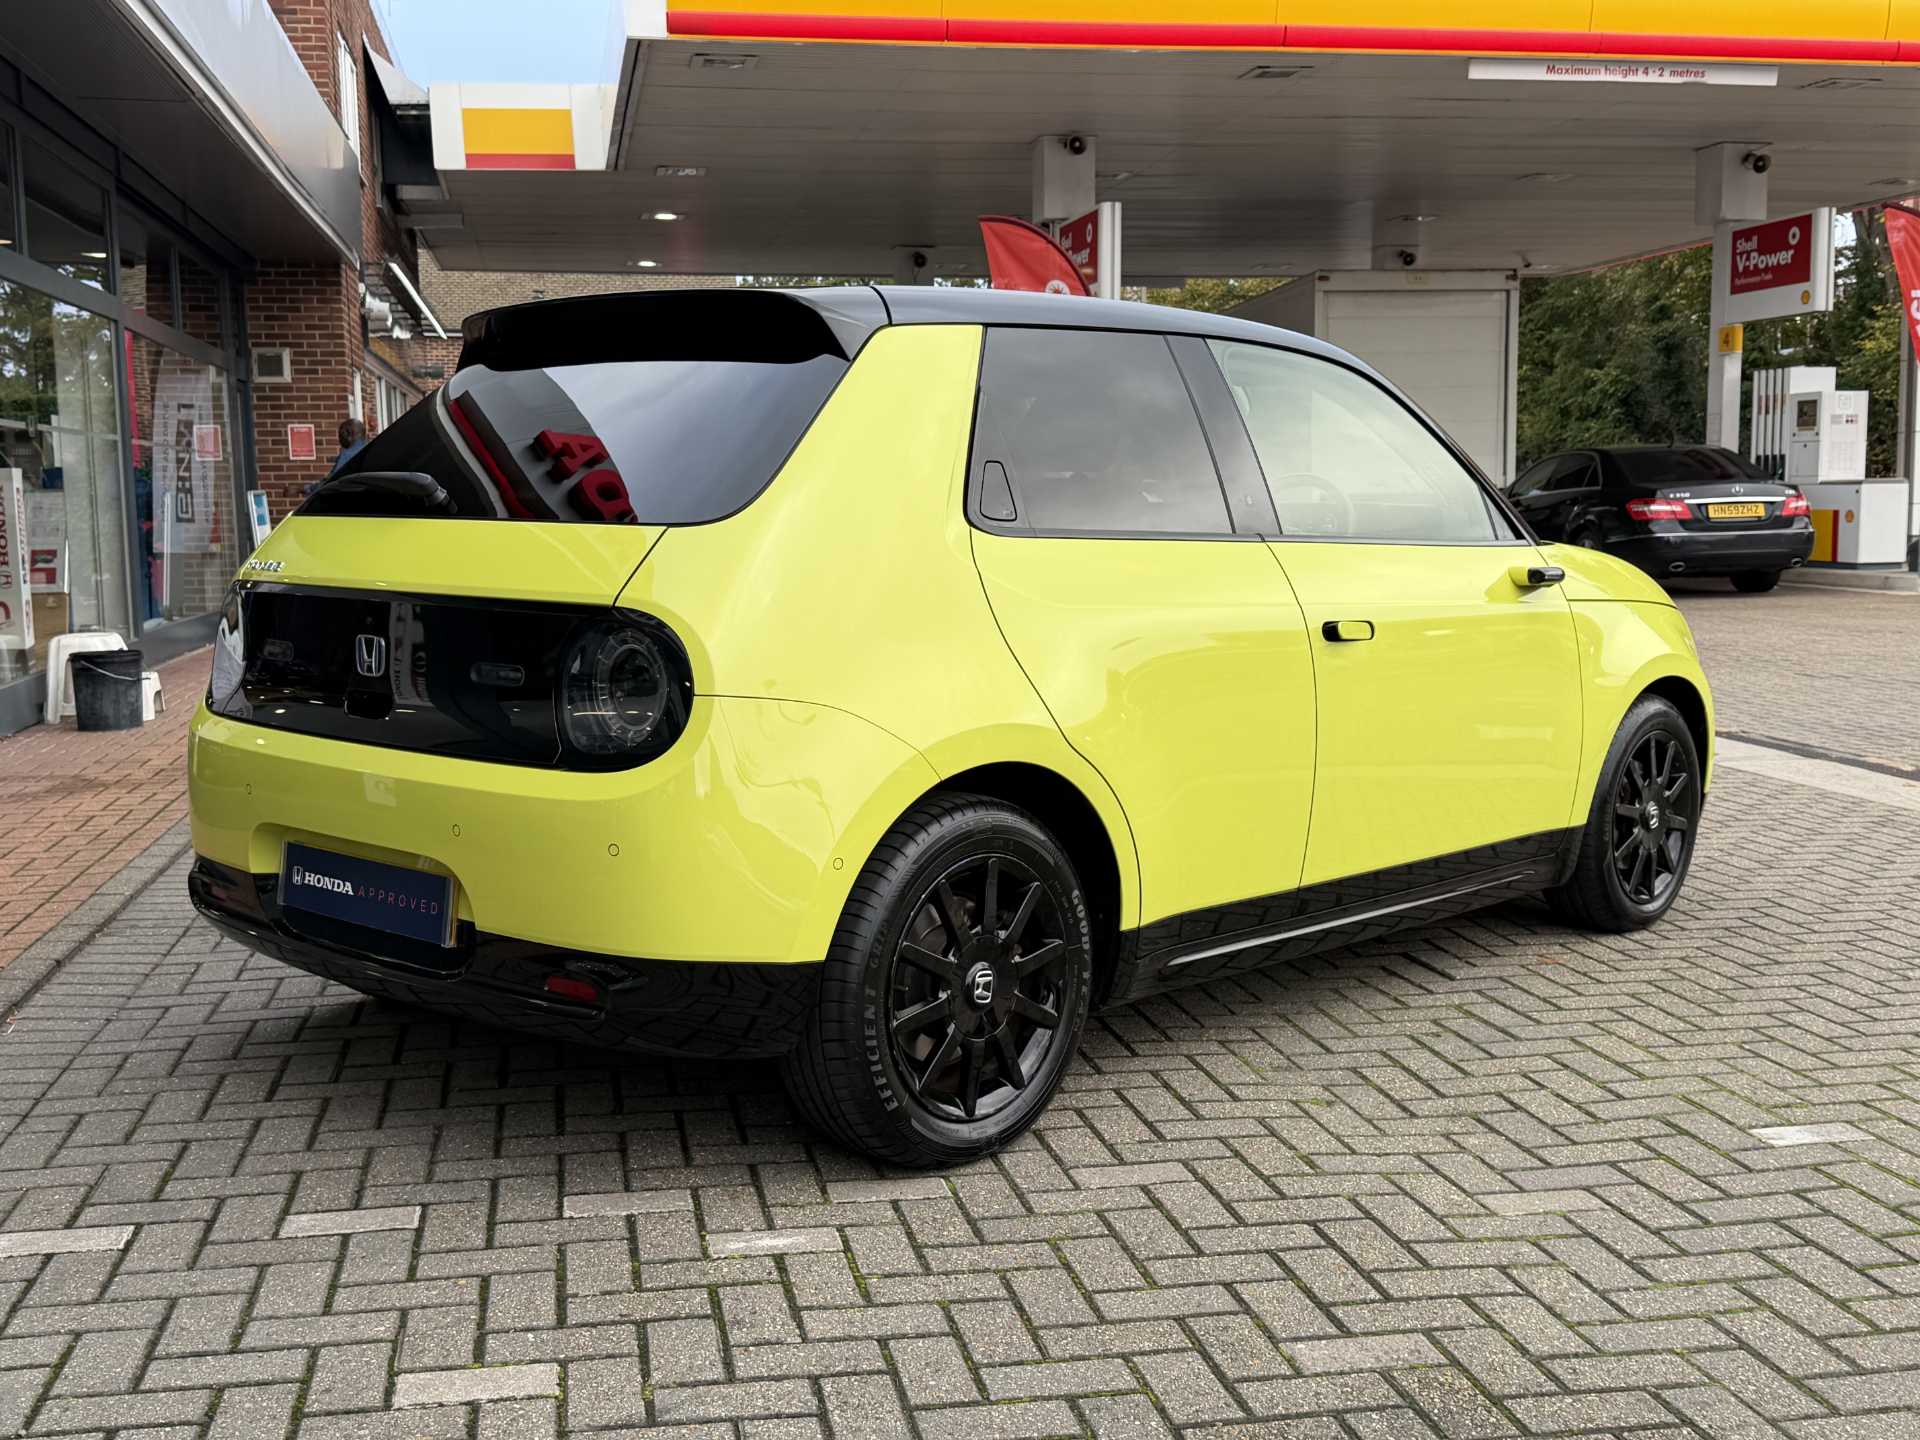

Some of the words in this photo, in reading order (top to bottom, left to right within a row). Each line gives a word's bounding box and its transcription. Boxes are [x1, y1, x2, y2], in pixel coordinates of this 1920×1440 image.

[1546, 64, 1601, 76] Maximum
[1604, 65, 1639, 79] height
[1669, 68, 1707, 79] metres
[1736, 235, 1758, 253] Shell
[1736, 249, 1794, 273] V-Power
[303, 872, 354, 896] HONDA
[358, 885, 438, 914] APPROVED
[864, 987, 899, 1112] EFFICIENT
